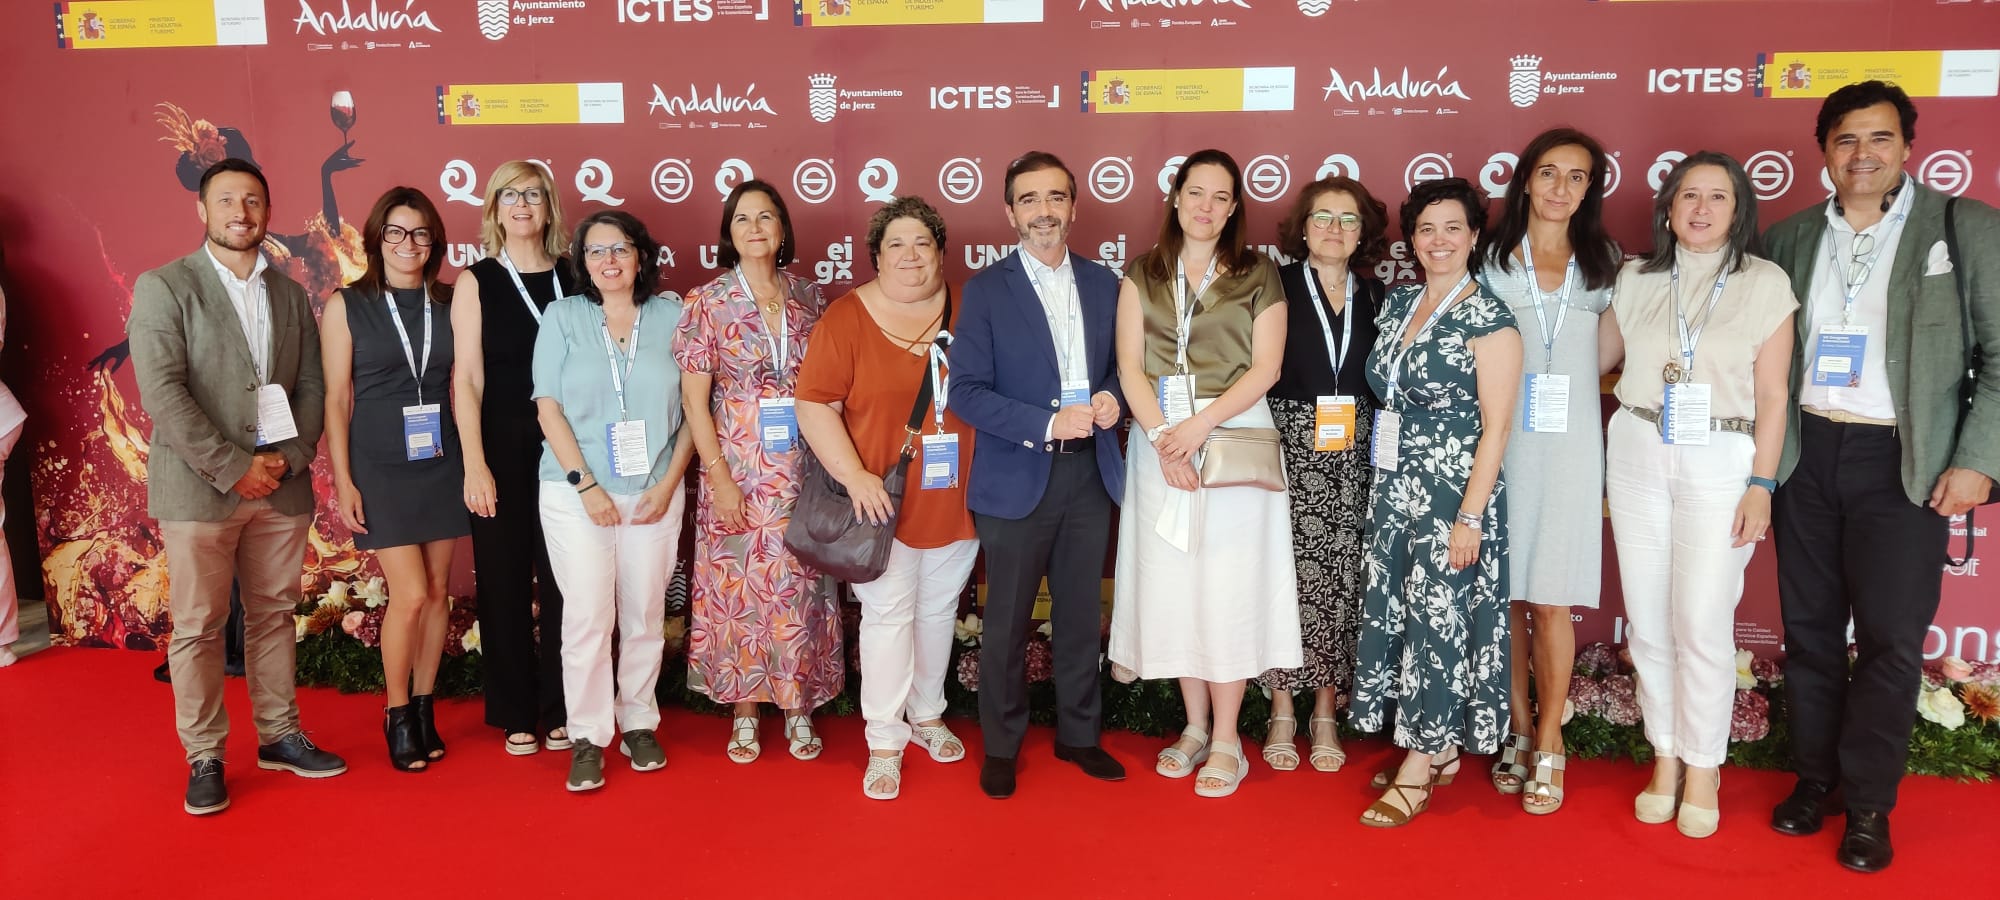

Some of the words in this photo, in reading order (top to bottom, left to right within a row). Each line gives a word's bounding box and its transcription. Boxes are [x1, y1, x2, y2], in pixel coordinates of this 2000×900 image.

[293, 0, 442, 35] Andalucía
[513, 0, 586, 12] Ayuntamiento
[617, 0, 713, 23] ICTES
[513, 15, 527, 24] de
[528, 14, 555, 26] Jerez
[1321, 65, 1472, 102] Andalucía
[1544, 71, 1617, 82] Ayuntamiento
[1648, 67, 1743, 93] ICTES
[648, 82, 778, 117] Andalucía
[840, 88, 903, 99] Ayuntamiento
[930, 85, 1012, 109] ICTES
[1544, 84, 1556, 93] de
[1557, 84, 1584, 95] Jerez
[840, 101, 851, 109] de
[852, 101, 876, 111] Jerez
[1668, 387, 1676, 440] PROGRAMA
